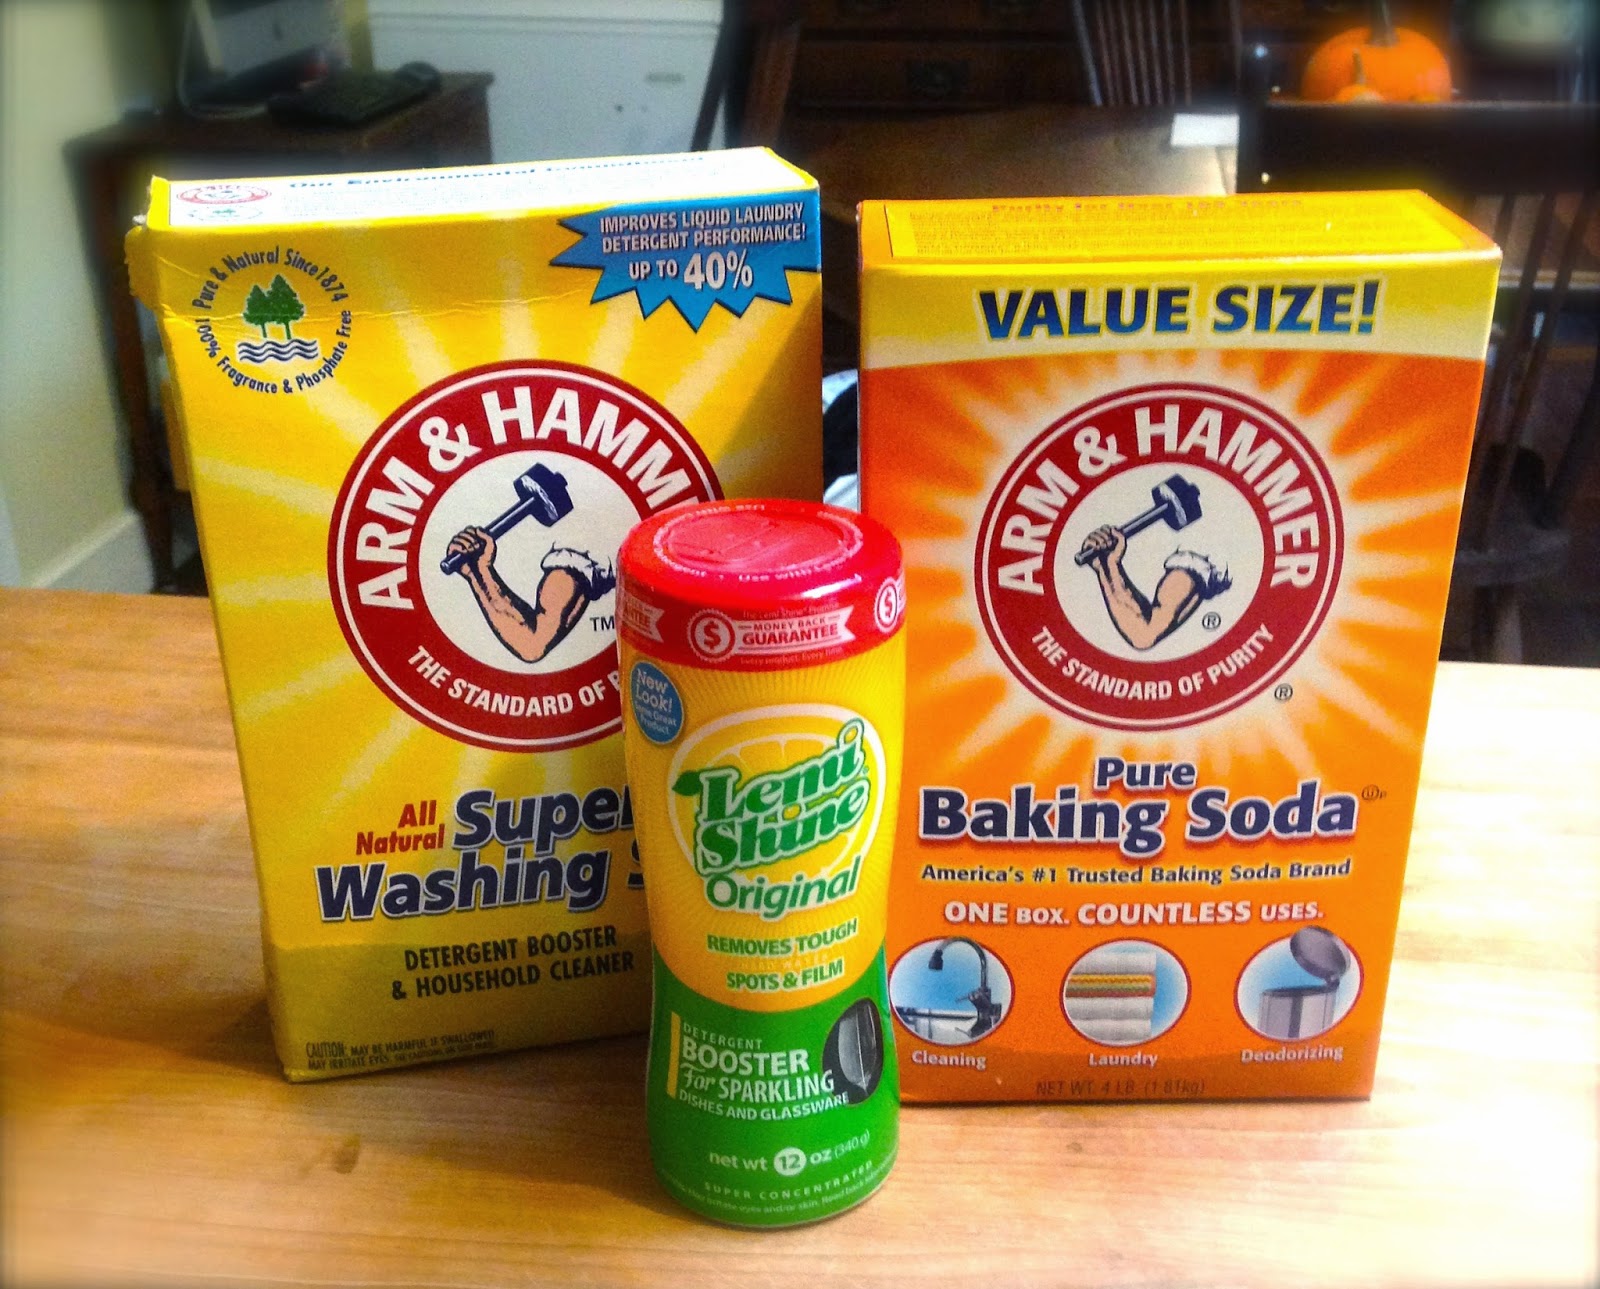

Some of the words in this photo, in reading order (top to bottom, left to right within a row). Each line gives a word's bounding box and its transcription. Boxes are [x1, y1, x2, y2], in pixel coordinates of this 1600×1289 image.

[600, 213, 677, 235] IMPROVES
[681, 207, 730, 230] LIQUID
[735, 202, 804, 225] LAUNDRY
[602, 231, 689, 254] DETERGENT
[693, 223, 806, 247] PERFORMANCE!
[192, 278, 219, 310] Pure
[209, 267, 227, 282] &
[222, 245, 280, 274] Natural
[284, 247, 319, 277] Since
[314, 268, 349, 303] 1874
[628, 261, 652, 280] UP
[656, 258, 678, 278] TO
[684, 248, 754, 290] 40%
[979, 287, 1191, 342] VALUE
[1212, 279, 1381, 336] SIZE!
[195, 318, 222, 360] 100%
[216, 356, 278, 395] Fragrance
[282, 379, 294, 394] &
[296, 338, 348, 392] Phosphate
[340, 310, 352, 339] Free
[356, 456, 436, 612] ARM
[418, 415, 483, 473] &
[481, 385, 701, 514] HAMM
[998, 457, 1080, 597] ARM
[1073, 424, 1128, 479] &
[1133, 403, 1321, 590] HAMMER
[742, 623, 838, 646] GUARANTEE
[753, 620, 795, 632] MONEY
[798, 616, 826, 629] BACK
[1031, 626, 1067, 667] THE
[1062, 660, 1173, 702] STANDARD
[1177, 672, 1204, 696] OF
[1208, 622, 1275, 686] PURITY
[408, 645, 452, 690] THE
[447, 677, 574, 718] STANDARD
[577, 680, 609, 707] OF
[635, 683, 673, 713] Look!
[636, 668, 669, 694] New
[700, 719, 866, 822] Lemi
[1096, 756, 1197, 792] Pure
[398, 800, 437, 828] All
[698, 781, 869, 873] Shine
[918, 783, 1170, 858] Baking
[1186, 779, 1358, 841] Soda
[356, 824, 446, 855] Natural
[314, 845, 611, 921] Washing
[705, 856, 862, 919] Original
[921, 864, 1024, 883] America's
[1032, 867, 1057, 883] #1
[1067, 867, 1143, 883] Trusted
[1151, 866, 1223, 886] Baking
[1230, 862, 1282, 881] Soda
[1289, 858, 1351, 878] Brand
[944, 901, 1008, 924] ONE
[1016, 905, 1070, 925] BOX.
[1077, 899, 1252, 925] COUNTLESS
[1261, 901, 1325, 921] USES.
[404, 938, 518, 971] DETERGENT
[528, 925, 617, 957] BOOSTER
[707, 934, 792, 956] REMOVES
[795, 919, 858, 951] TOUGH
[391, 980, 407, 1000] &
[416, 965, 541, 999] HOUSEHOLD
[550, 952, 635, 982] CLEANER
[726, 971, 779, 990] SPOTS
[782, 971, 798, 989] &
[801, 958, 844, 986] FILM
[683, 1022, 762, 1050] DETERGENT
[1241, 1044, 1344, 1063] Deodorizing
[682, 1036, 810, 1077] BOOSTER
[911, 1049, 986, 1070] Cleaning
[1088, 1051, 1159, 1068] Laundry
[718, 1069, 835, 1104] SPARKLING
[1035, 1080, 1065, 1096] NET
[679, 1089, 724, 1116] DISHES
[726, 1105, 757, 1120] AND
[760, 1092, 850, 1121] GLASSWARE
[709, 1151, 738, 1169] net
[743, 1156, 768, 1172] wt
[779, 1154, 801, 1170] 12
[810, 1148, 832, 1165] oz
[705, 1181, 751, 1199] SUPER
[759, 1160, 873, 1199] CONCENTRATED
